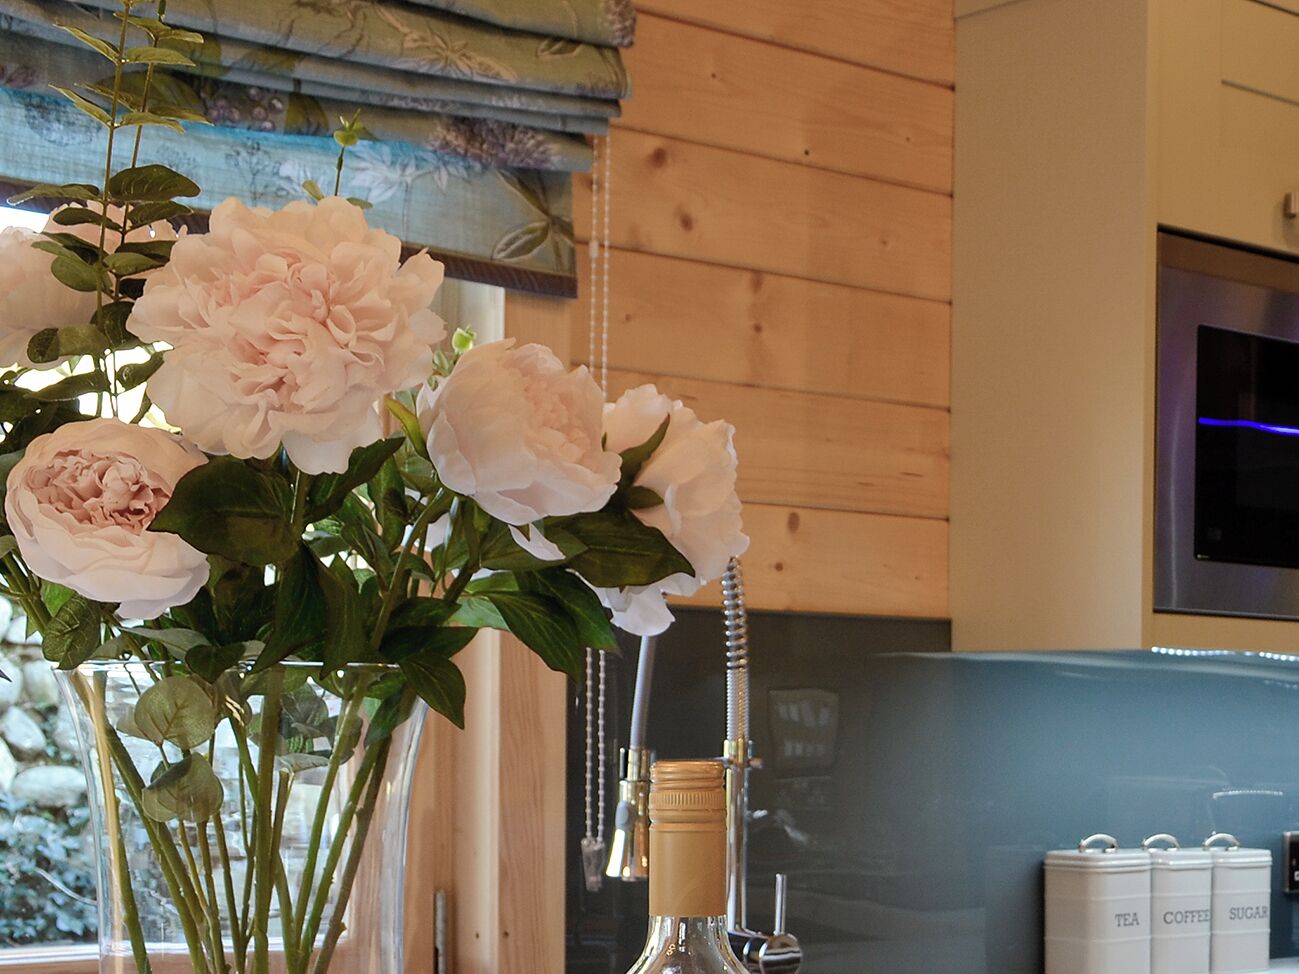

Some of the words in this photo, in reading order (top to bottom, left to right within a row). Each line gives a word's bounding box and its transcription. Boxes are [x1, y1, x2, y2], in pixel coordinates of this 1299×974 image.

[1114, 912, 1140, 928] TEA
[1162, 909, 1210, 925] COFFEE
[1228, 905, 1269, 921] SUGAR
